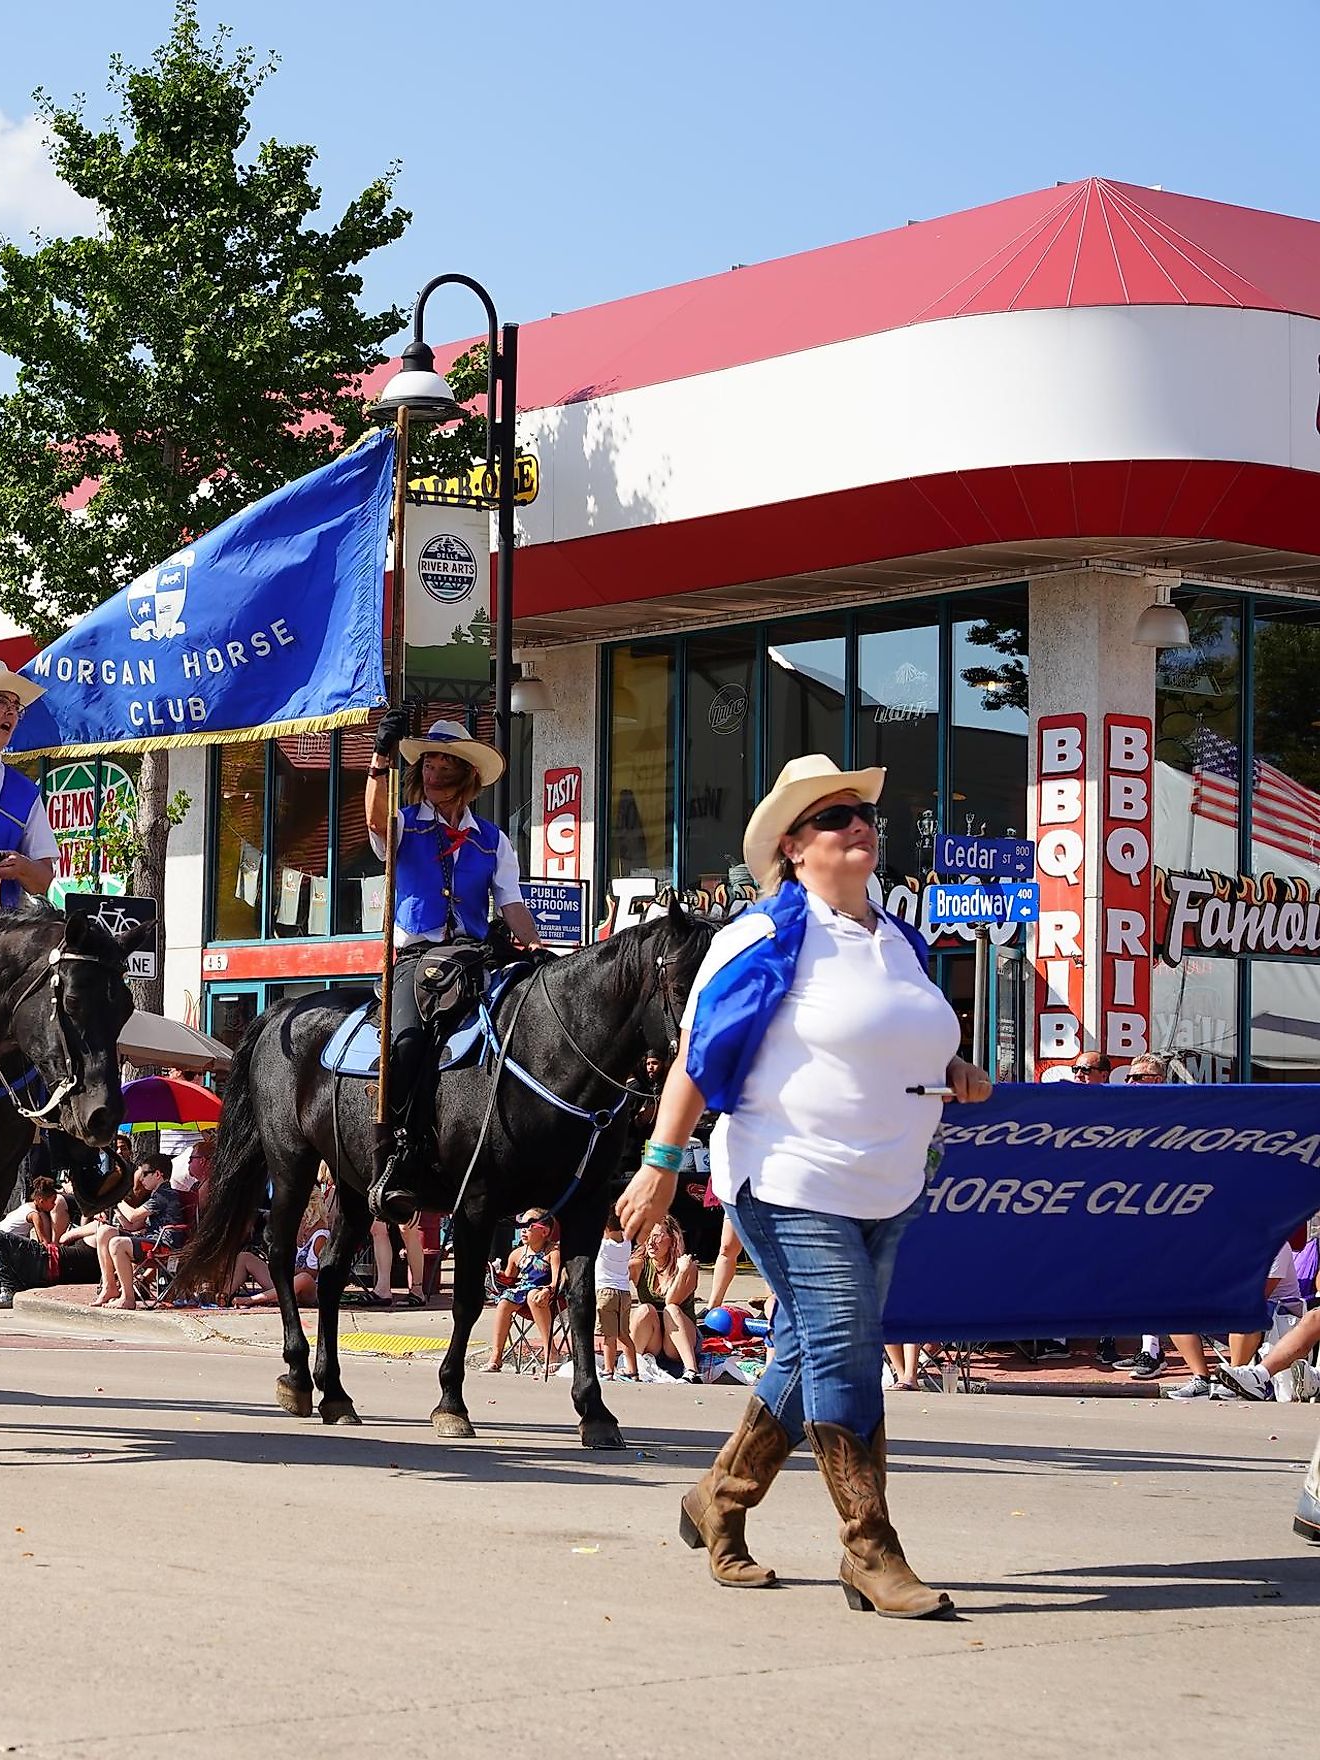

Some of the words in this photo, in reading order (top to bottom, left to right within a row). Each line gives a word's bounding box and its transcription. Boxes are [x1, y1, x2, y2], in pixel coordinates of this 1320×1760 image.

[421, 560, 449, 573] RIVER
[452, 563, 475, 575] ARTS
[436, 552, 459, 560] DELLS
[34, 653, 156, 685] MORGAN
[182, 618, 295, 679] HORSE
[130, 697, 206, 726] CLUB
[546, 774, 578, 812] TASTY
[1037, 727, 1084, 886] BBQ
[1105, 724, 1149, 887] BBQ
[48, 790, 94, 830] GEMS
[944, 838, 998, 869] Cedar
[1002, 854, 1012, 864] ST
[1015, 846, 1030, 857] 800
[524, 899, 579, 912] ESTROOMS
[531, 887, 567, 900] PUBLIC
[937, 888, 1014, 921] Broadway
[1017, 888, 1033, 899] 400
[927, 1176, 1086, 1216] HORSE
[1085, 1181, 1214, 1217] CLUB
